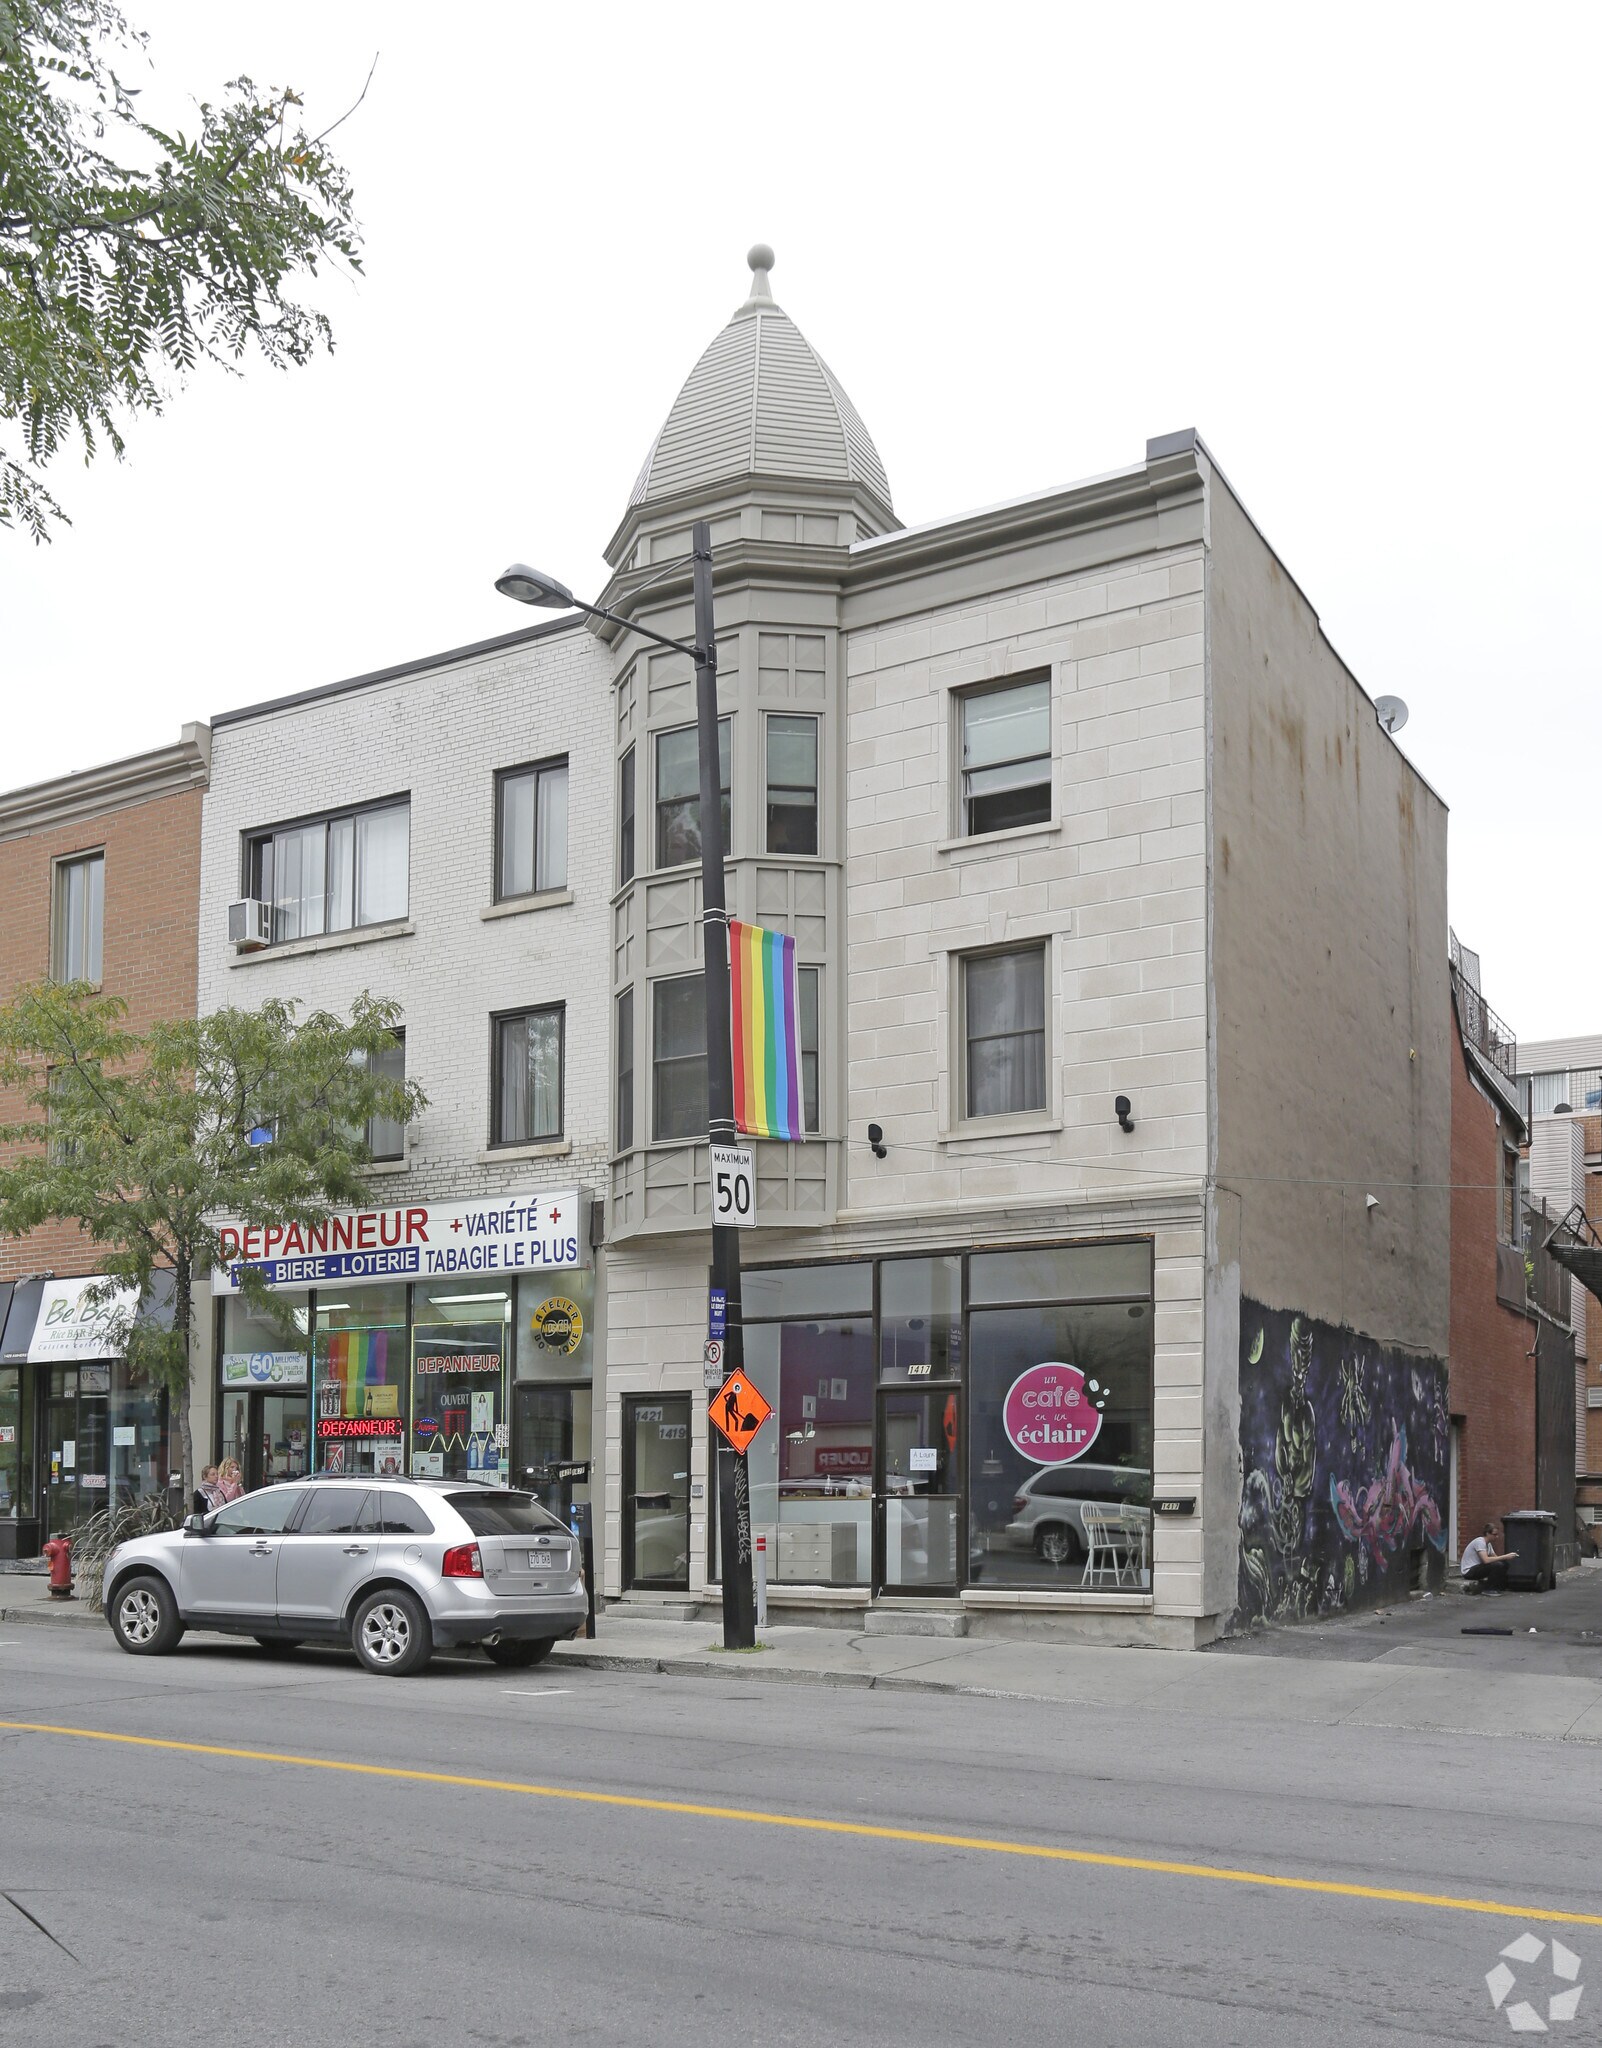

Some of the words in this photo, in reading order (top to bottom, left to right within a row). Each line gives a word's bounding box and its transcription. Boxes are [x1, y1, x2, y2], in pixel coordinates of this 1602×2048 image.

[714, 1152, 750, 1165] MAXIMUM
[717, 1172, 750, 1215] 50
[220, 1207, 430, 1261] DEPANNEUR
[465, 1197, 538, 1237] VARIÉTÉ
[425, 1244, 499, 1273] TABAGIE
[504, 1241, 525, 1266] LE
[531, 1237, 577, 1264] PLUS
[275, 1259, 326, 1281] BIERE
[341, 1250, 417, 1275] LOTERIE
[535, 1299, 578, 1328] ATELIER
[50, 1330, 65, 1340] Rice
[66, 1329, 86, 1339] BAR
[38, 1343, 69, 1351] Cuisine
[251, 1353, 273, 1375] 50
[275, 1355, 301, 1364] MILLIONS
[417, 1354, 500, 1374] DEPANNEUR
[909, 1365, 931, 1374] 1417
[1044, 1376, 1058, 1384] un
[440, 1393, 470, 1406] OUVERT
[1021, 1385, 1081, 1408] café
[635, 1410, 662, 1421] 1421
[1034, 1413, 1047, 1421] en
[322, 1421, 396, 1435] DEPANNEUR
[659, 1427, 686, 1439] 1419
[1016, 1423, 1088, 1444] éclair
